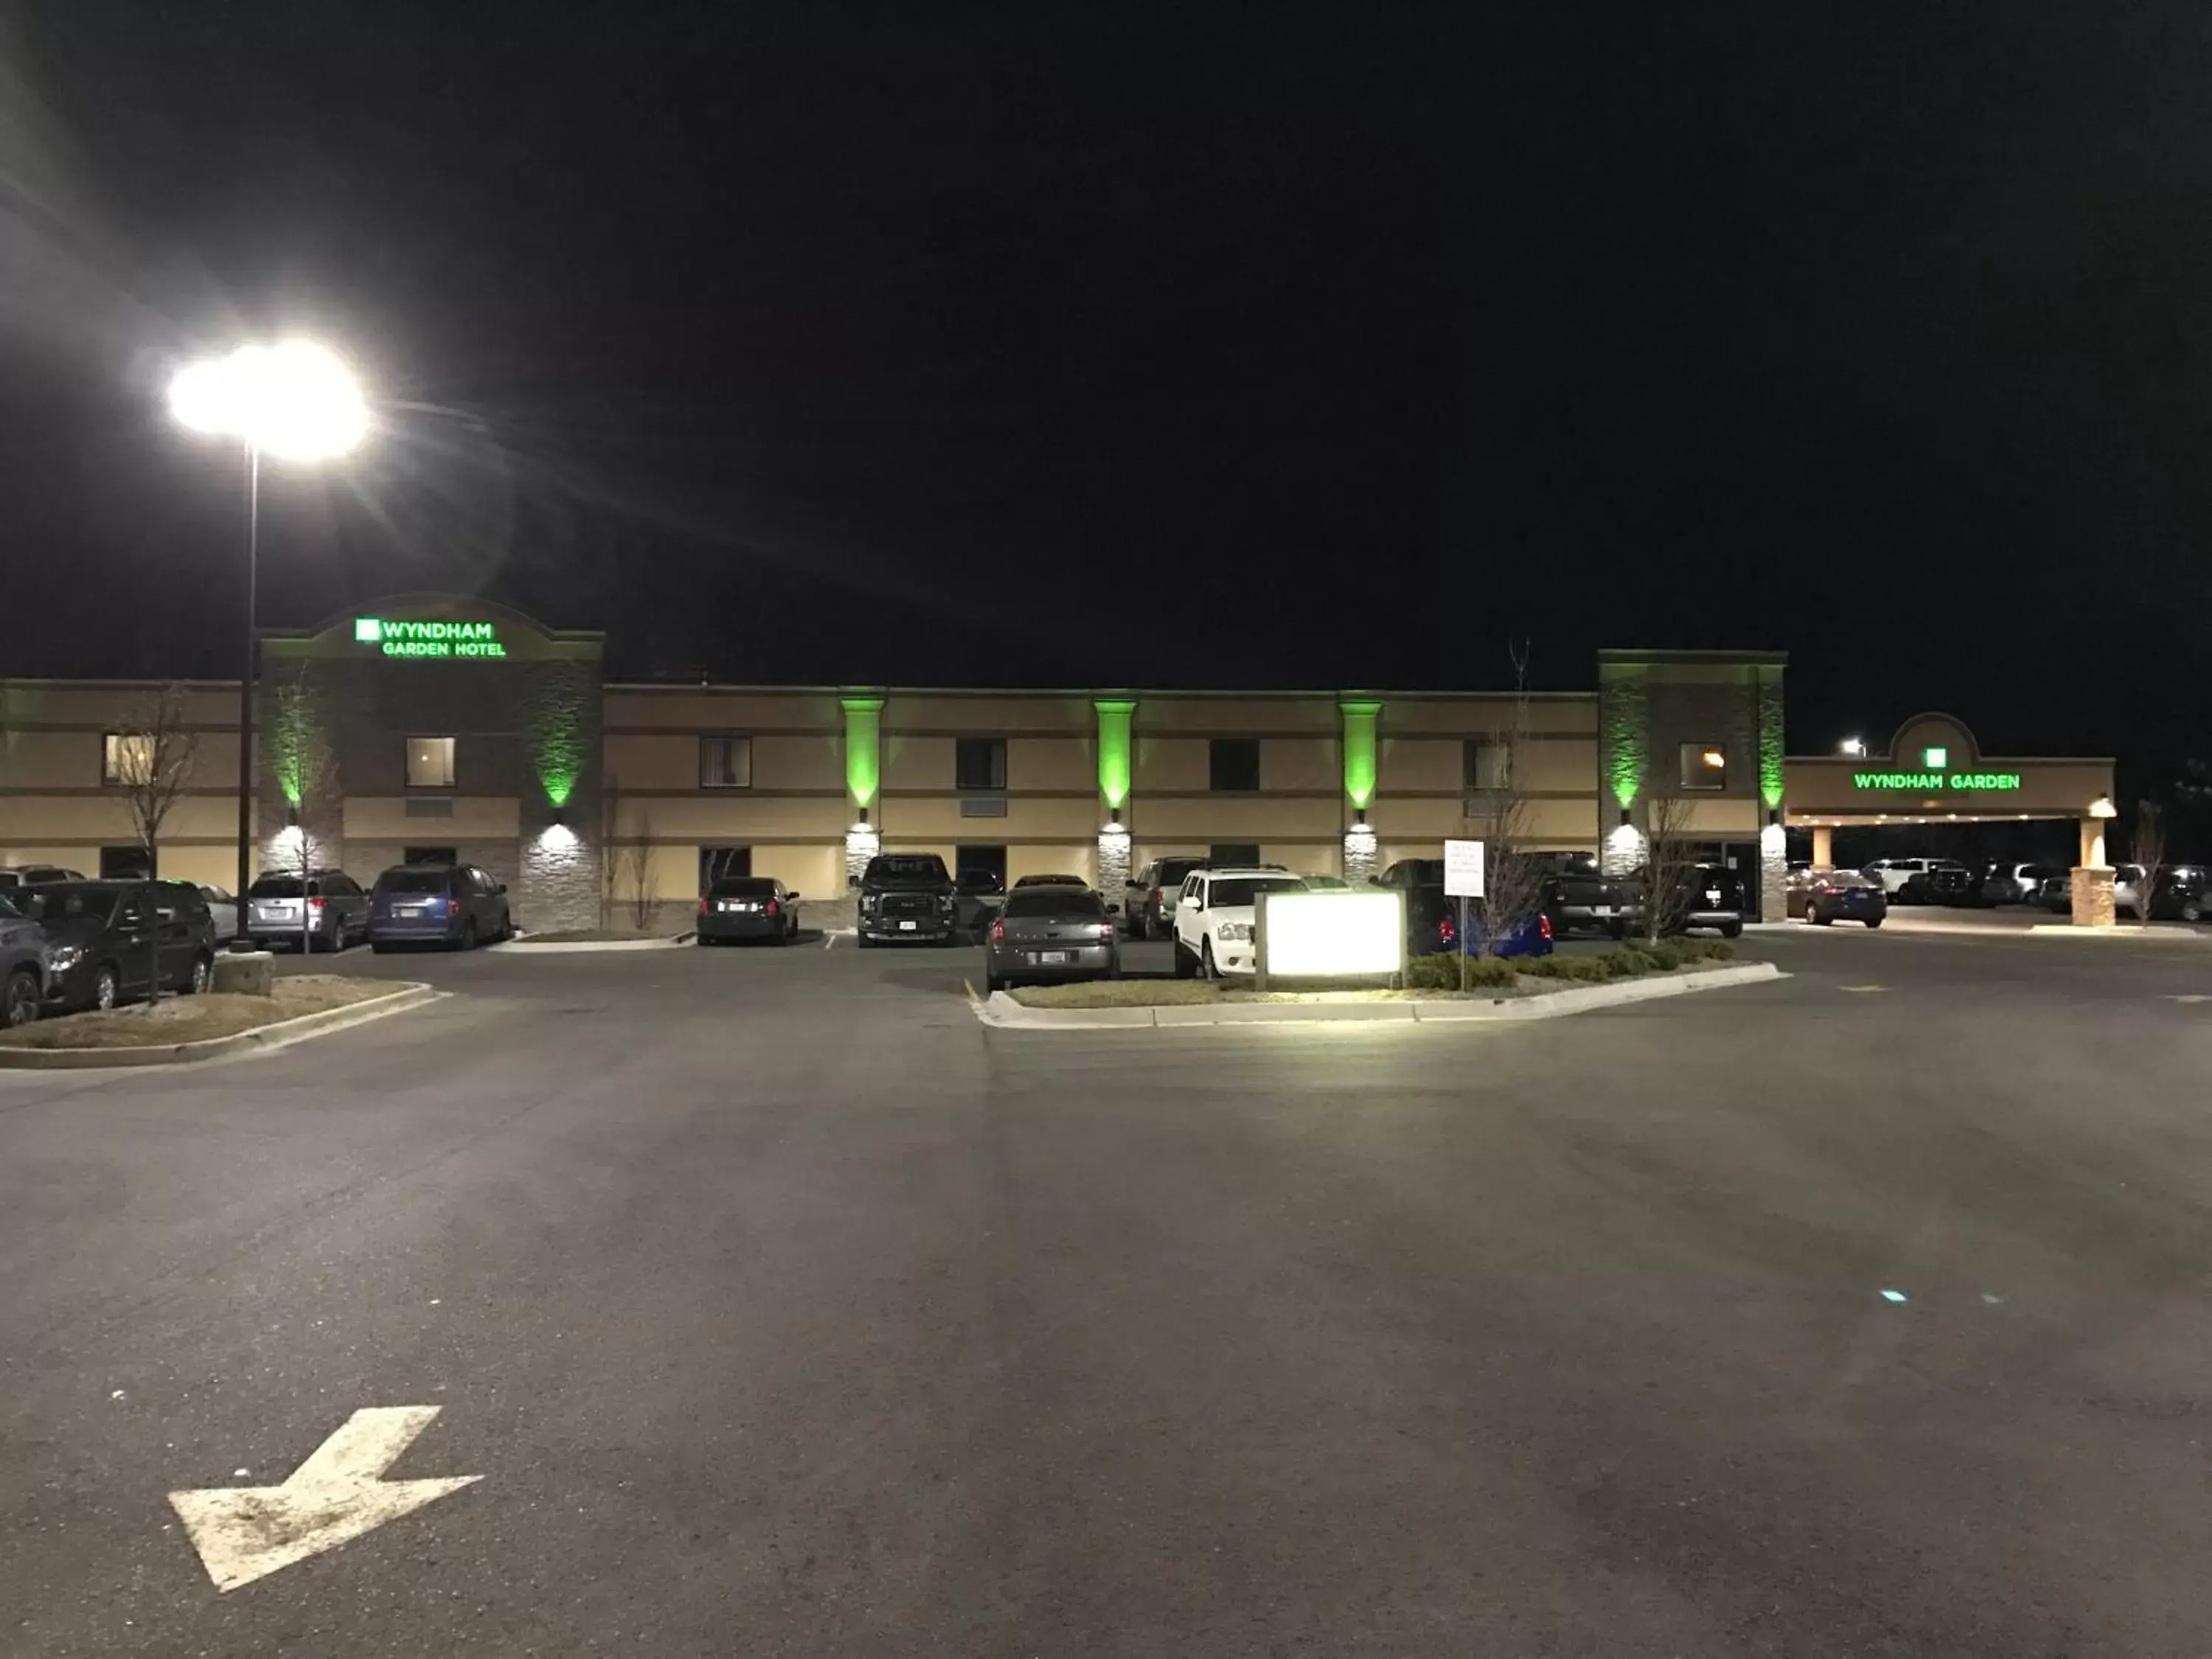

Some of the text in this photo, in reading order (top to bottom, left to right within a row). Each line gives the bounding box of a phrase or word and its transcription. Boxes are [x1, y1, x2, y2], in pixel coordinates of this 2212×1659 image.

[383, 622, 492, 639] WYNDHAM
[383, 642, 507, 655] GARDEN HOTEL
[1854, 774, 2020, 789] WYNDHAM GARDEN
